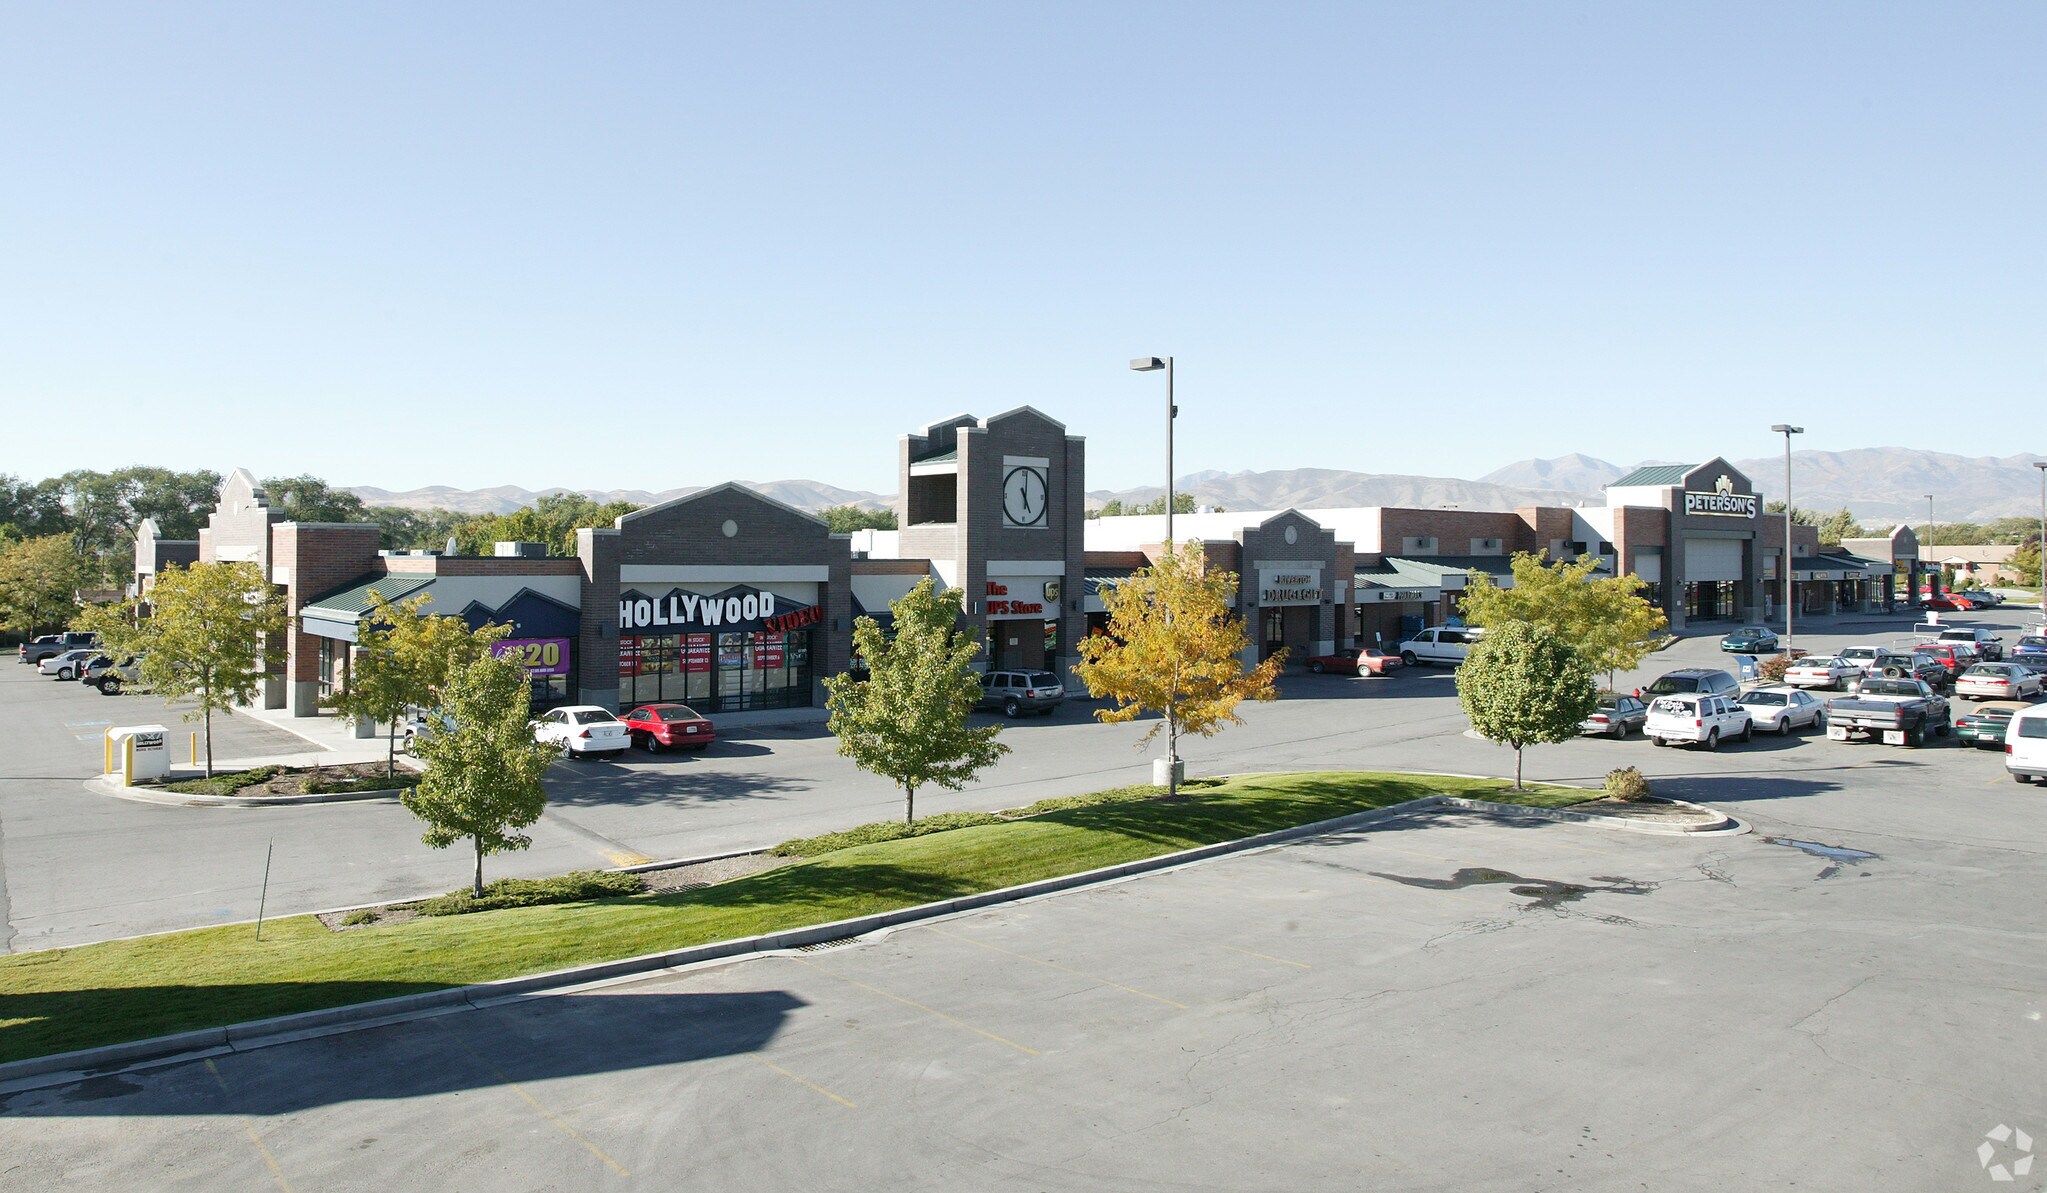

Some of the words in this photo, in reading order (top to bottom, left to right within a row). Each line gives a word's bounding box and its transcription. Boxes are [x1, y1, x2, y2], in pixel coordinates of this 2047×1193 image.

[1685, 494, 1756, 519] PETERSON'S
[987, 582, 1008, 595] The
[620, 591, 775, 628] HOLLYWOOD
[763, 604, 823, 634] VIDEO
[987, 600, 1010, 615] UPS
[1011, 600, 1043, 614] Store
